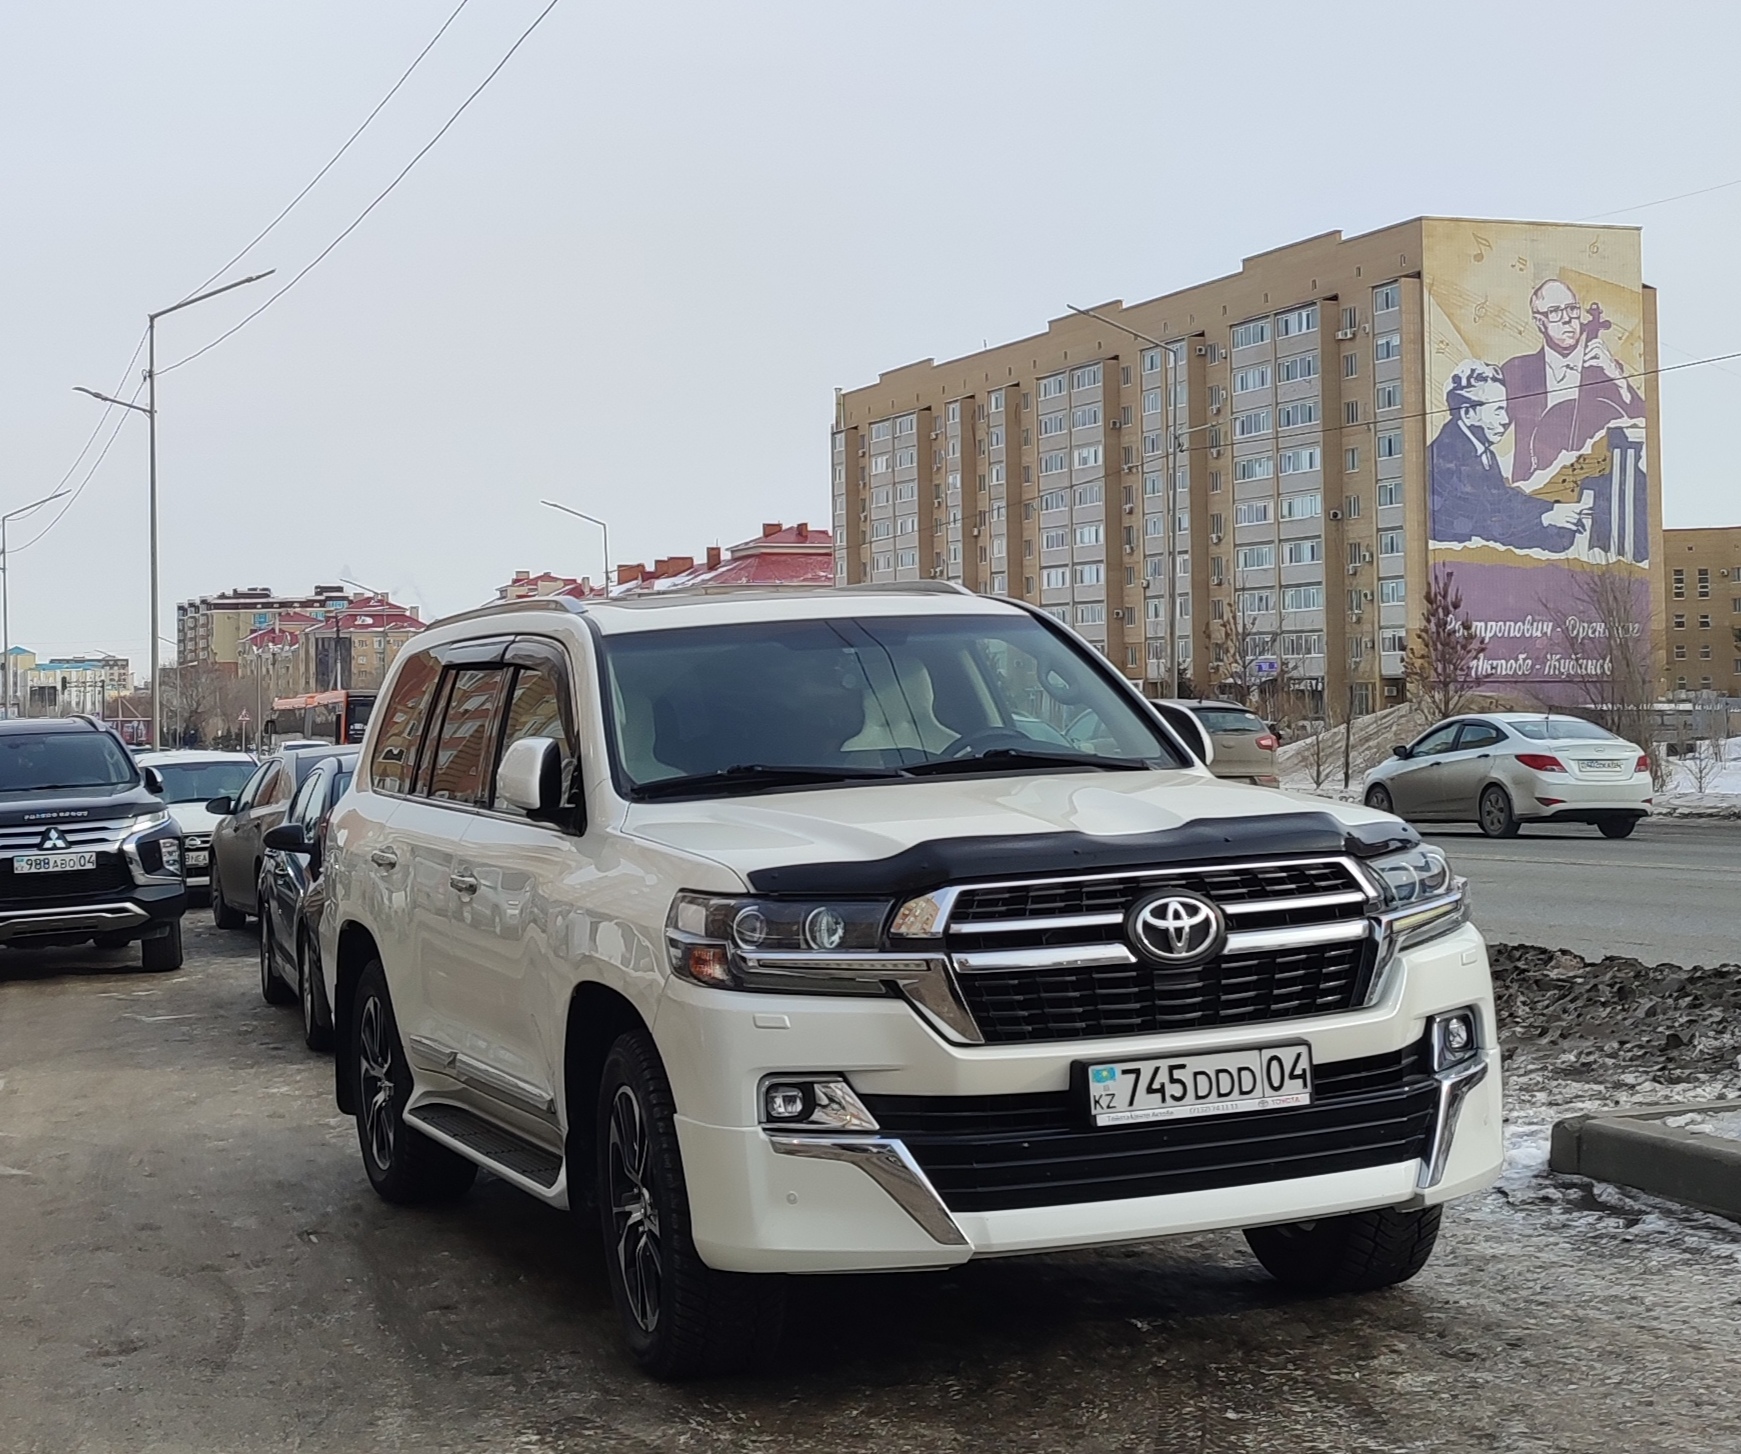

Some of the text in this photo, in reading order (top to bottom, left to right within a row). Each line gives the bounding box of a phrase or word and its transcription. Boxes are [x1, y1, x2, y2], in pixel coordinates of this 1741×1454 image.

[1446, 614, 1554, 644] Ротропович
[1468, 652, 1532, 678] Актобе
[1265, 1051, 1309, 1093] 04
[1093, 1092, 1117, 1111] KZ
[1271, 1095, 1301, 1106] TOYOTA
